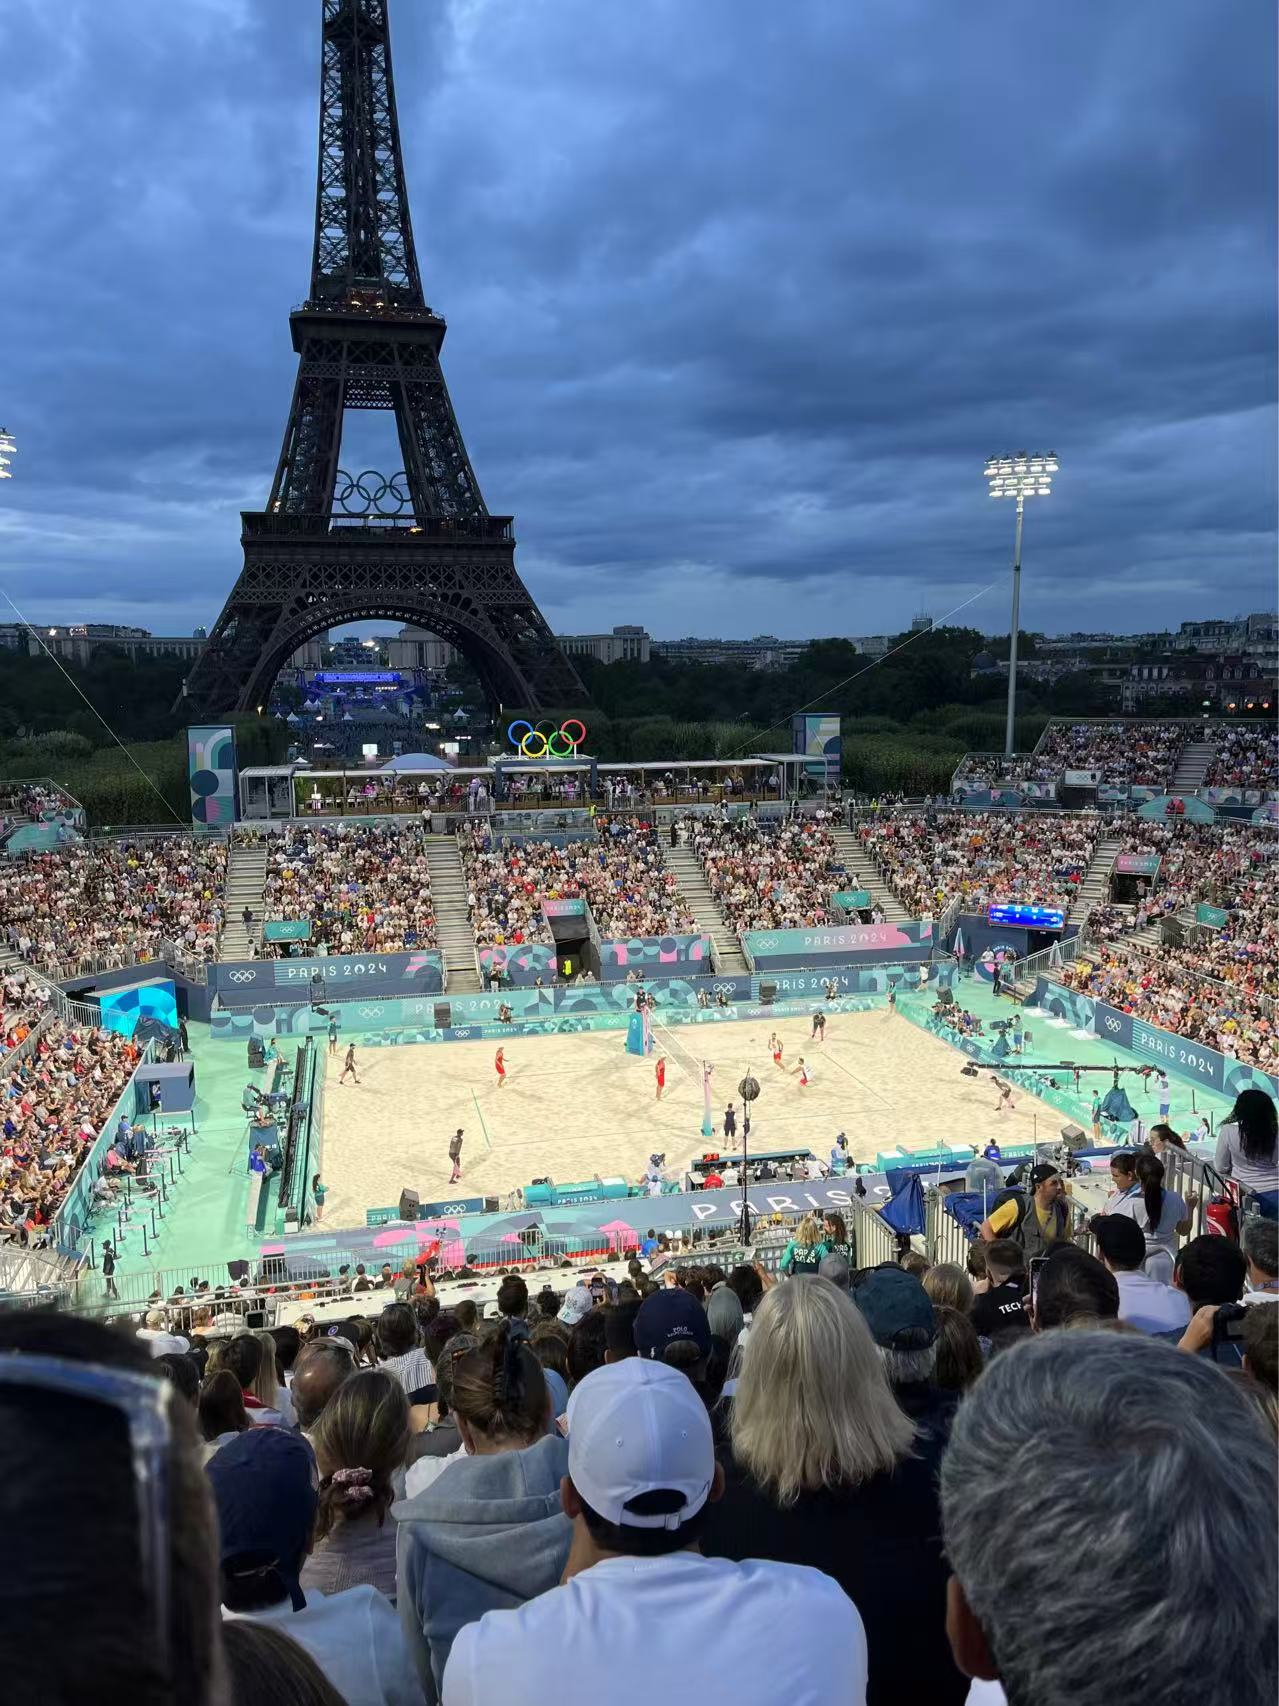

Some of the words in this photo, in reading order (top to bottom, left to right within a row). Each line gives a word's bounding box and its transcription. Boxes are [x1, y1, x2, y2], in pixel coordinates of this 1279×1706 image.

[804, 935, 845, 945] PARIS
[850, 932, 887, 944] 2024
[288, 966, 337, 978] PARIS
[343, 963, 387, 976] 2024
[811, 976, 849, 988] 2024
[1141, 1033, 1176, 1058] PARIS
[1180, 1050, 1214, 1076] 2024
[691, 1190, 852, 1220] PARIS
